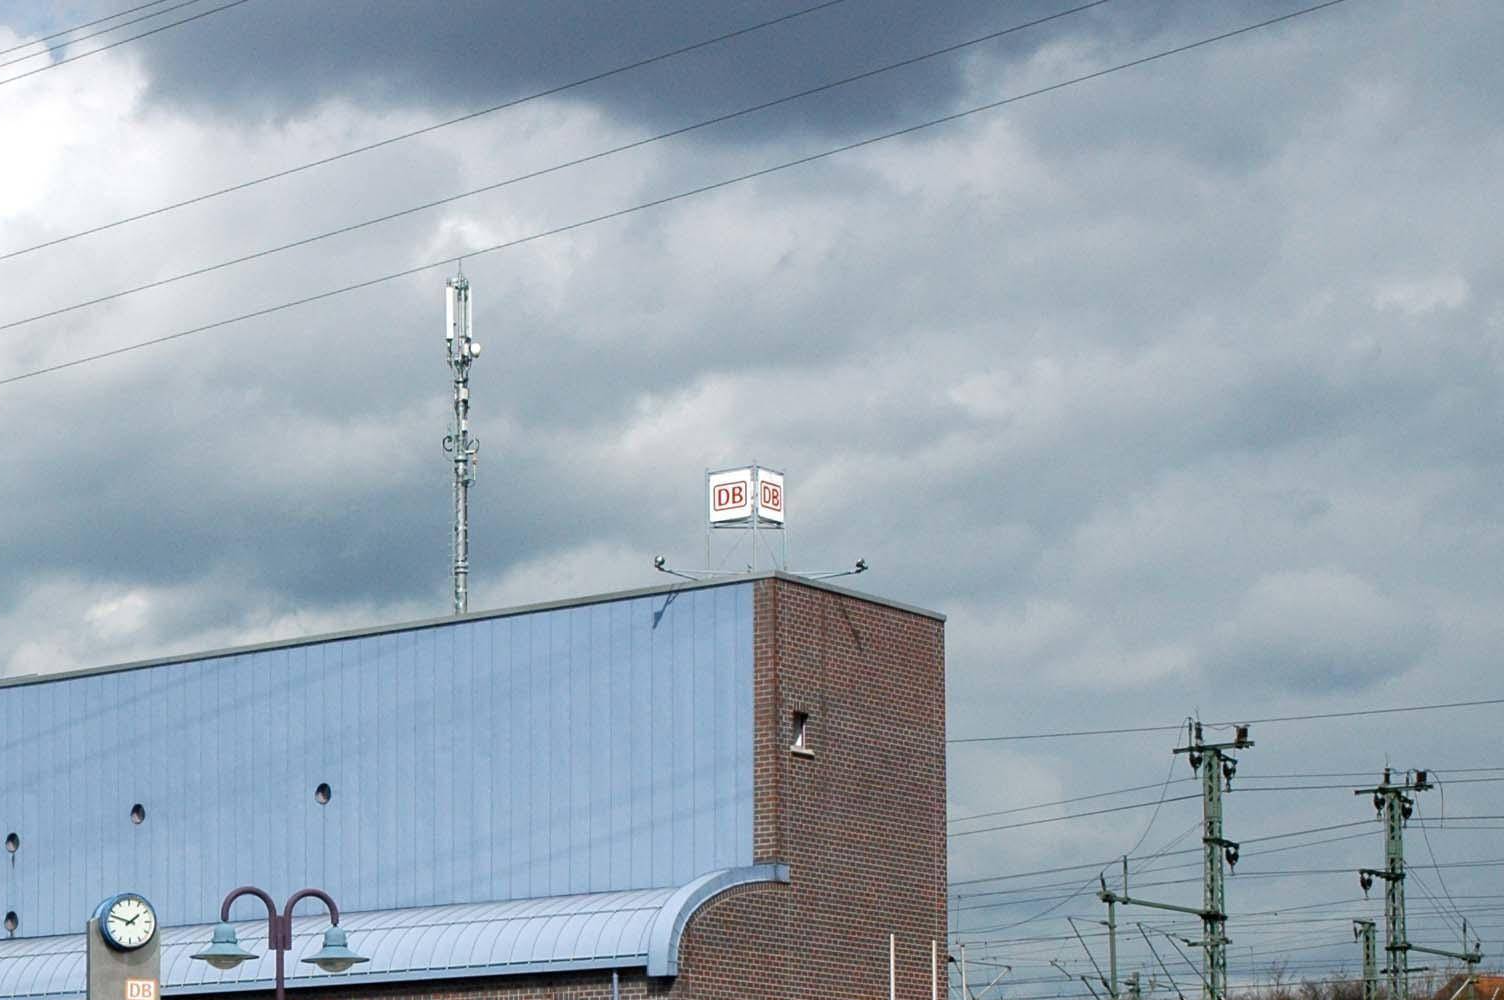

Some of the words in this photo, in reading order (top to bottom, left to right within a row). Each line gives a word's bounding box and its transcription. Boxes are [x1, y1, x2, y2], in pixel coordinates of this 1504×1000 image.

[718, 486, 744, 507] DB
[763, 486, 780, 507] DB
[130, 983, 152, 998] DB
